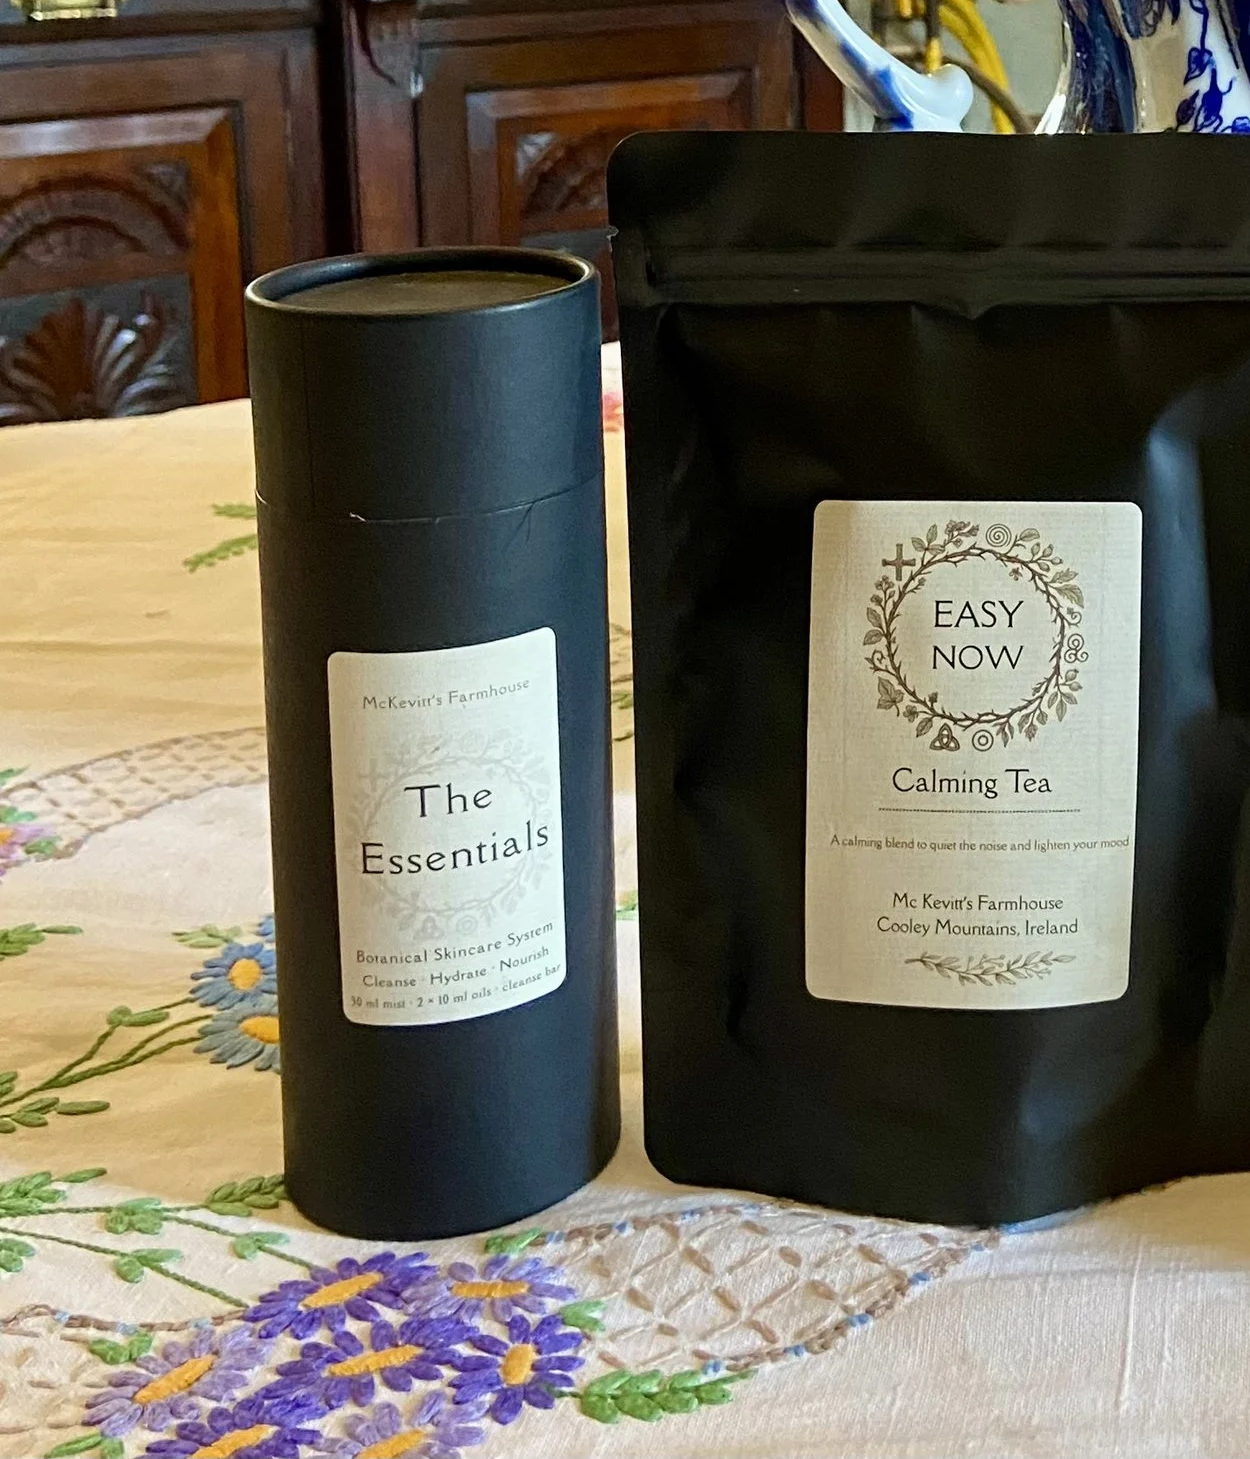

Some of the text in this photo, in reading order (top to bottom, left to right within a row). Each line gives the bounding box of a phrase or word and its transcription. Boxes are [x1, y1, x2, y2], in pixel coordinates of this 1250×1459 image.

[934, 600, 1024, 629] EASY
[932, 645, 1024, 671] NOW
[363, 680, 530, 710] McKevitt's Farmhouse
[892, 767, 1053, 799] Calming Tea
[404, 783, 493, 818] The
[360, 821, 549, 875] Essentials
[830, 834, 1130, 853] A calming blend to quiet the noise and lighten your mood
[893, 892, 1063, 911] Mc Kevitt's Farmhouse
[877, 916, 1079, 937] Cooley Mountains, Ireland
[357, 921, 554, 964] Botanical Skincare System
[362, 946, 550, 988] Cleanse Hydrate Nourish
[366, 997, 379, 1009] ml
[382, 999, 406, 1009] mist
[417, 996, 424, 1008] 2
[438, 994, 449, 1006] 10
[453, 992, 468, 1004] ml
[471, 988, 492, 1000] oils
[502, 972, 542, 992] cleanse
[544, 963, 561, 977] bar
